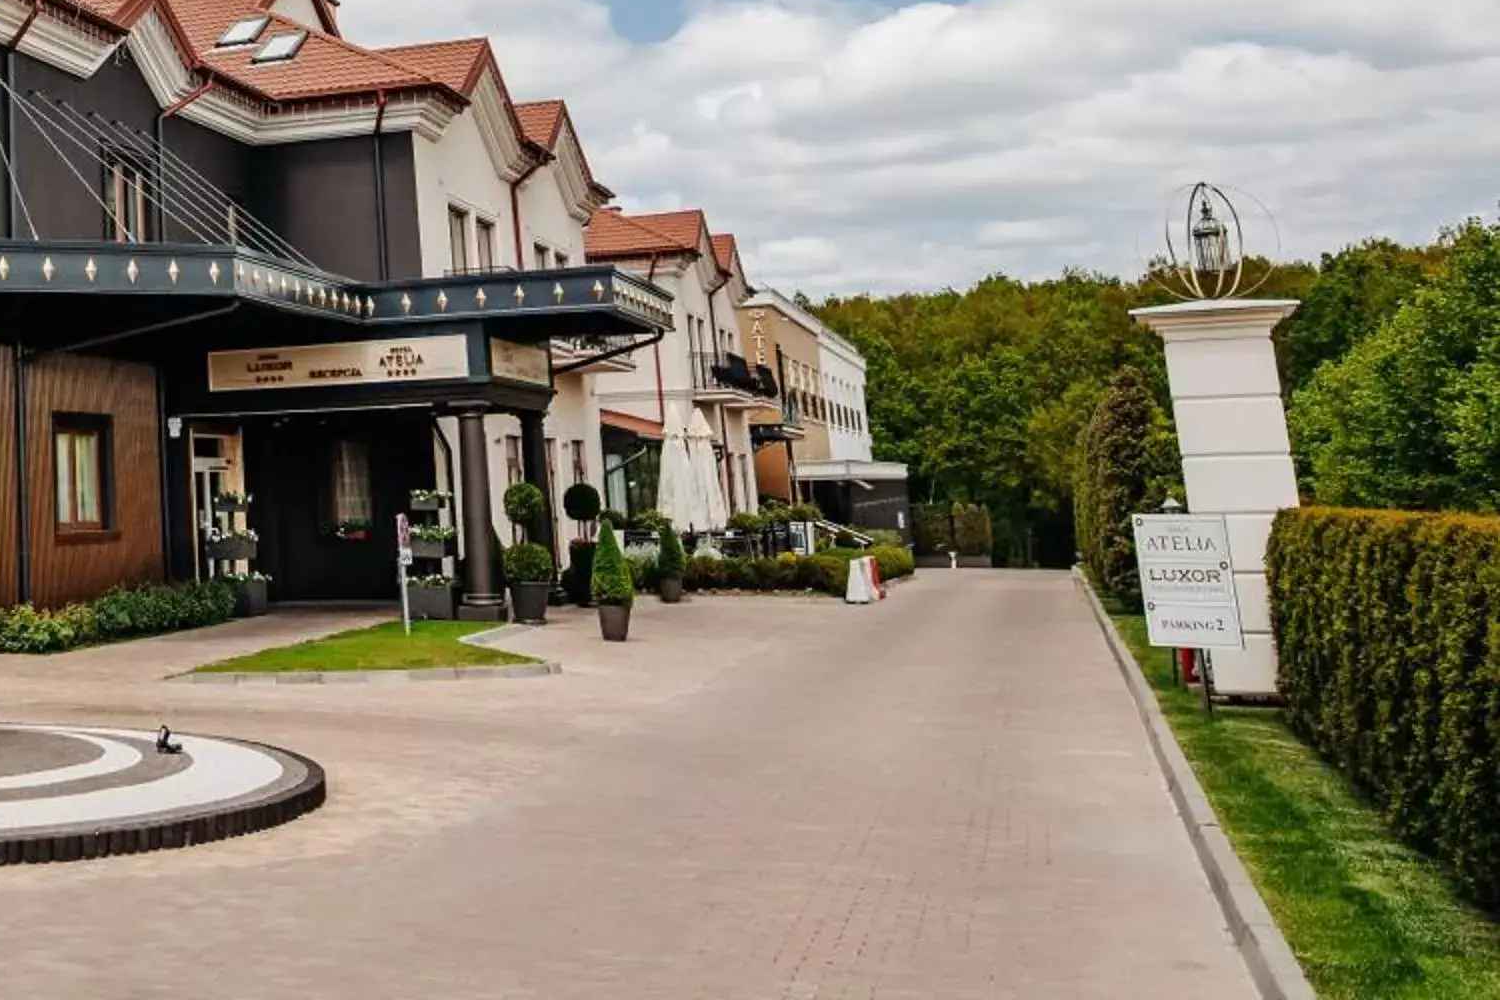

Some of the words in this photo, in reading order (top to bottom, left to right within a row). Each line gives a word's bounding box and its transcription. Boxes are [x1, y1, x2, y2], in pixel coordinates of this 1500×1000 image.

[1147, 535, 1217, 551] ATELIA
[1150, 569, 1221, 583] LUXOR
[1161, 619, 1215, 631] PARKING
